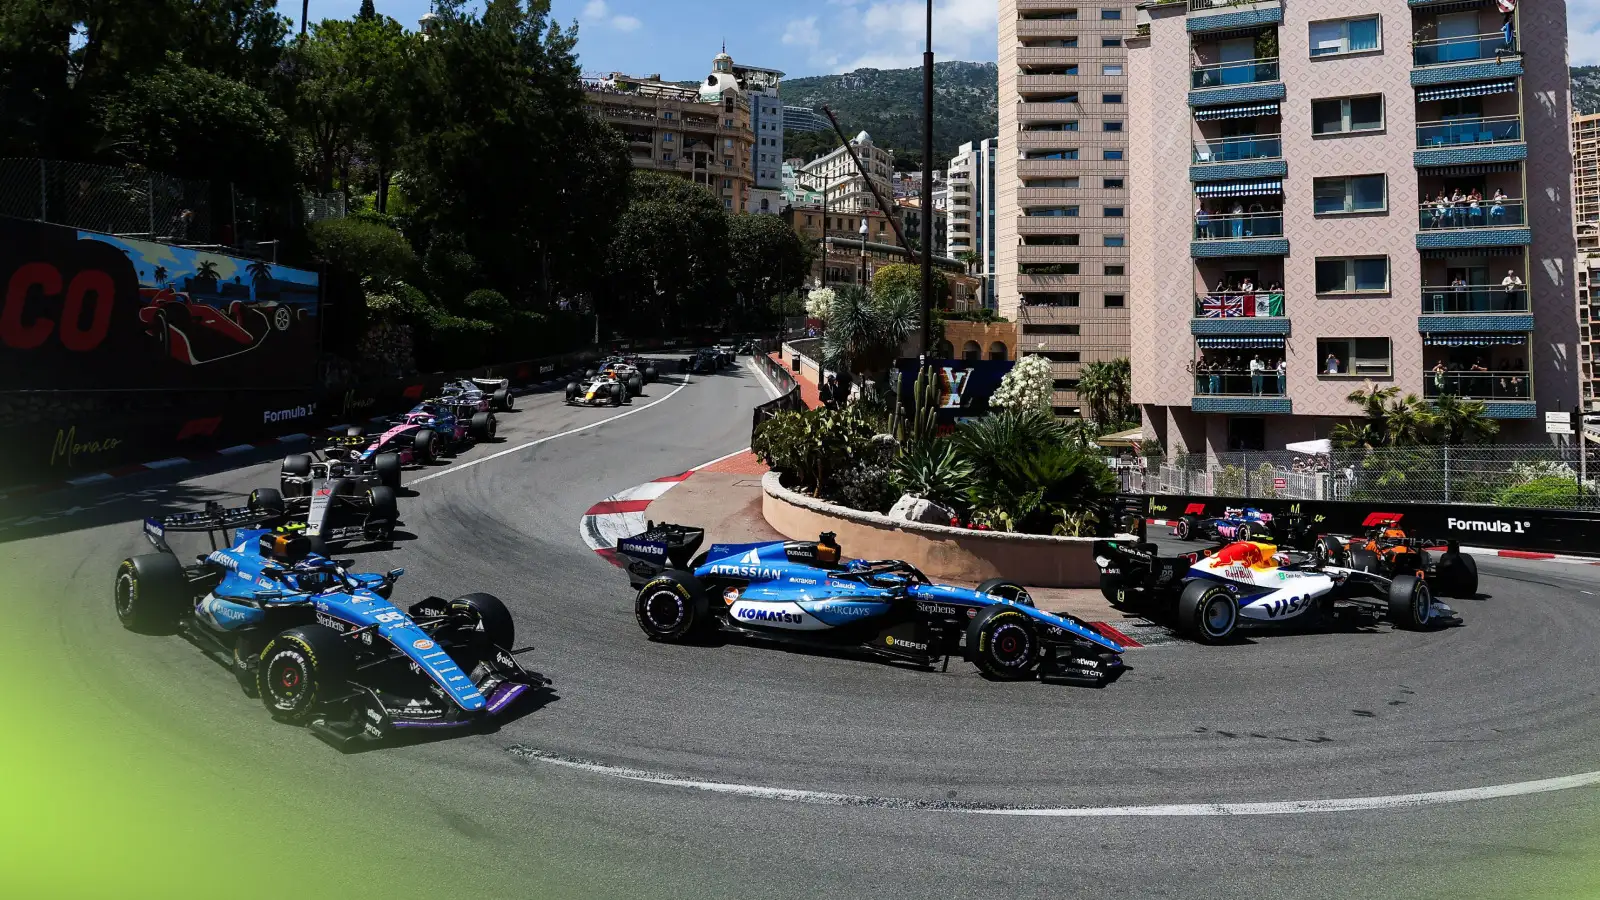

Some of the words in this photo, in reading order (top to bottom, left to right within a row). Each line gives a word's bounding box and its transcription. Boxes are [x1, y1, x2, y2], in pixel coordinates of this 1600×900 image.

[1, 261, 116, 352] CO
[263, 405, 306, 424] Formula
[51, 425, 122, 467] Monaco
[1447, 517, 1511, 533] Formula
[622, 543, 664, 555] KOMATSU
[787, 549, 814, 558] DURACELL
[1118, 545, 1135, 556] Cash
[710, 564, 781, 580] ATLASSIAN
[1225, 569, 1239, 578] Red
[831, 580, 857, 590] Claude
[824, 605, 870, 616] BARCLAYS
[916, 602, 956, 615] Stephens
[1259, 593, 1311, 618] VISA
[315, 612, 345, 633] Stephens
[738, 607, 803, 625] KOMATSU
[894, 638, 928, 651] KEEPER
[1089, 669, 1105, 678] CITY
